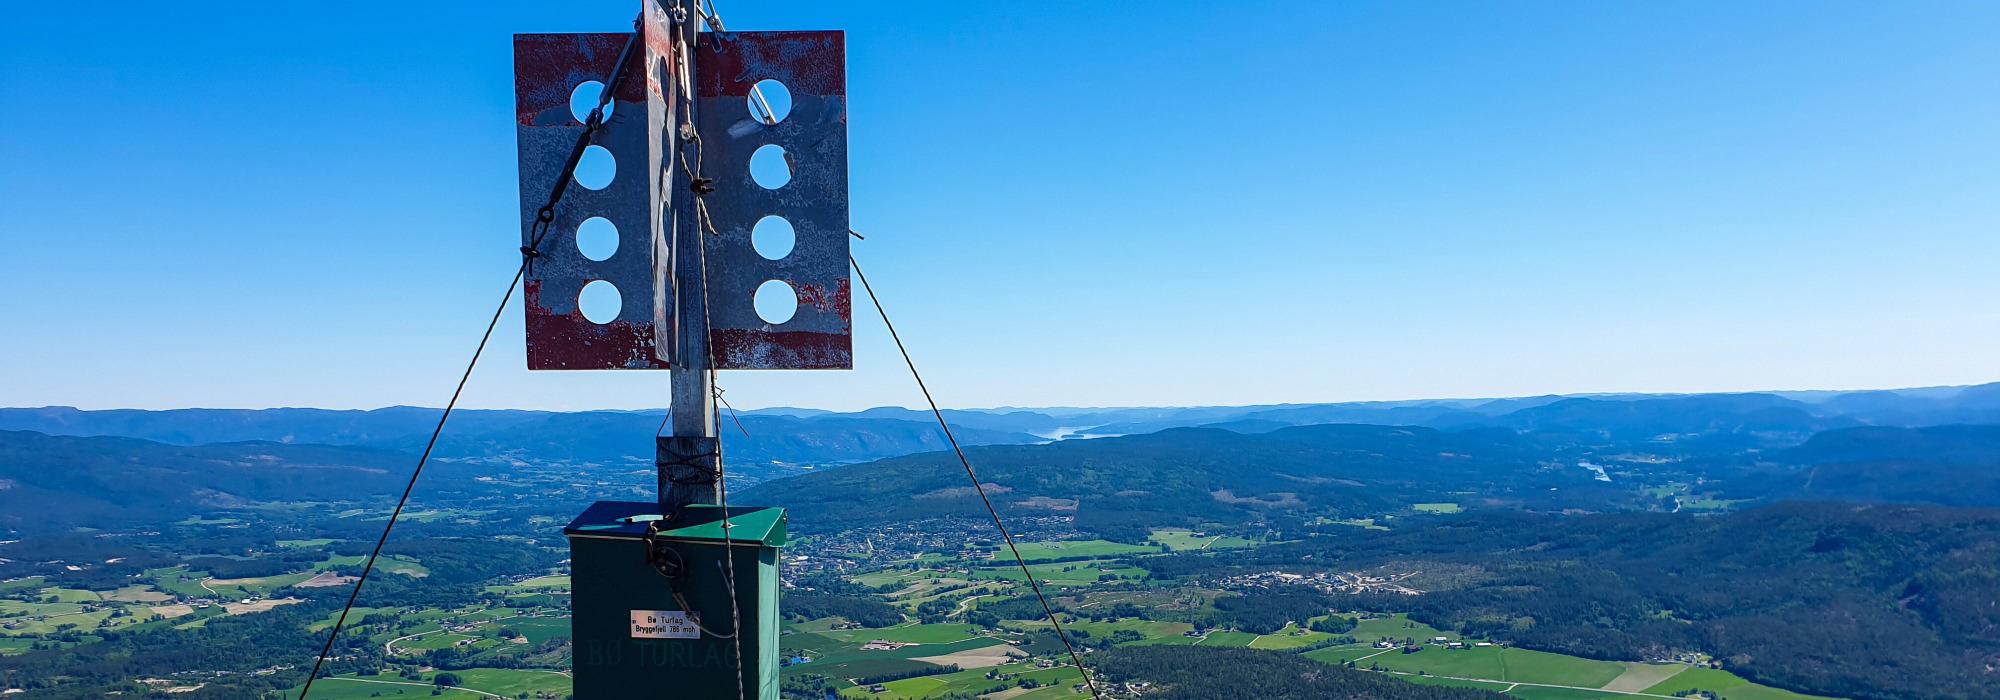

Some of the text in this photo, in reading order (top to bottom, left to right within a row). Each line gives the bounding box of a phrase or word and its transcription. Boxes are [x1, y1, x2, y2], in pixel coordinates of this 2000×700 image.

[661, 616, 684, 625] Turlag
[635, 625, 667, 634] Bryggefjell
[633, 640, 738, 668] TURLAG
